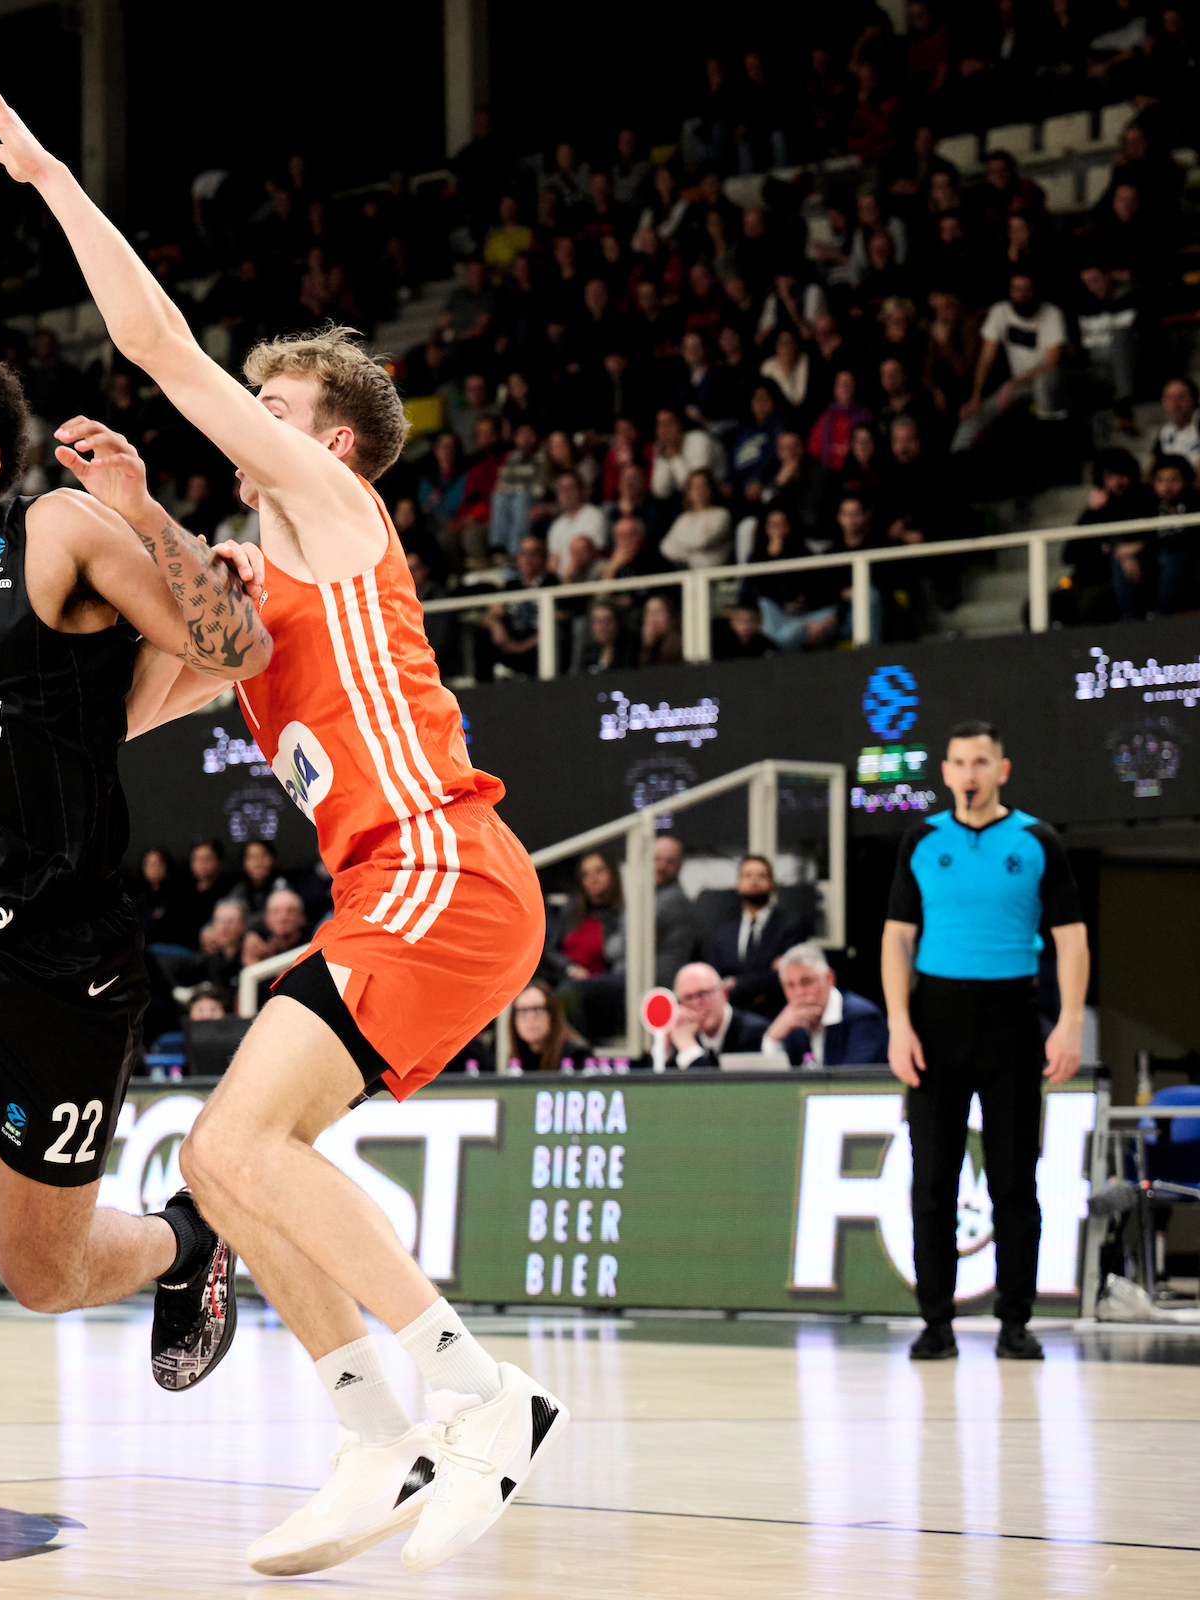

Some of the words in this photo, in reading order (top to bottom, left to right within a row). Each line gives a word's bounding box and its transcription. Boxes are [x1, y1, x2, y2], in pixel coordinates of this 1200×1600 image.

[43, 1099, 104, 1164] 22
[535, 1090, 627, 1135] BIRRA
[528, 1199, 622, 1243] BEER
[525, 1252, 619, 1298] BIER
[436, 1332, 461, 1352] adidas
